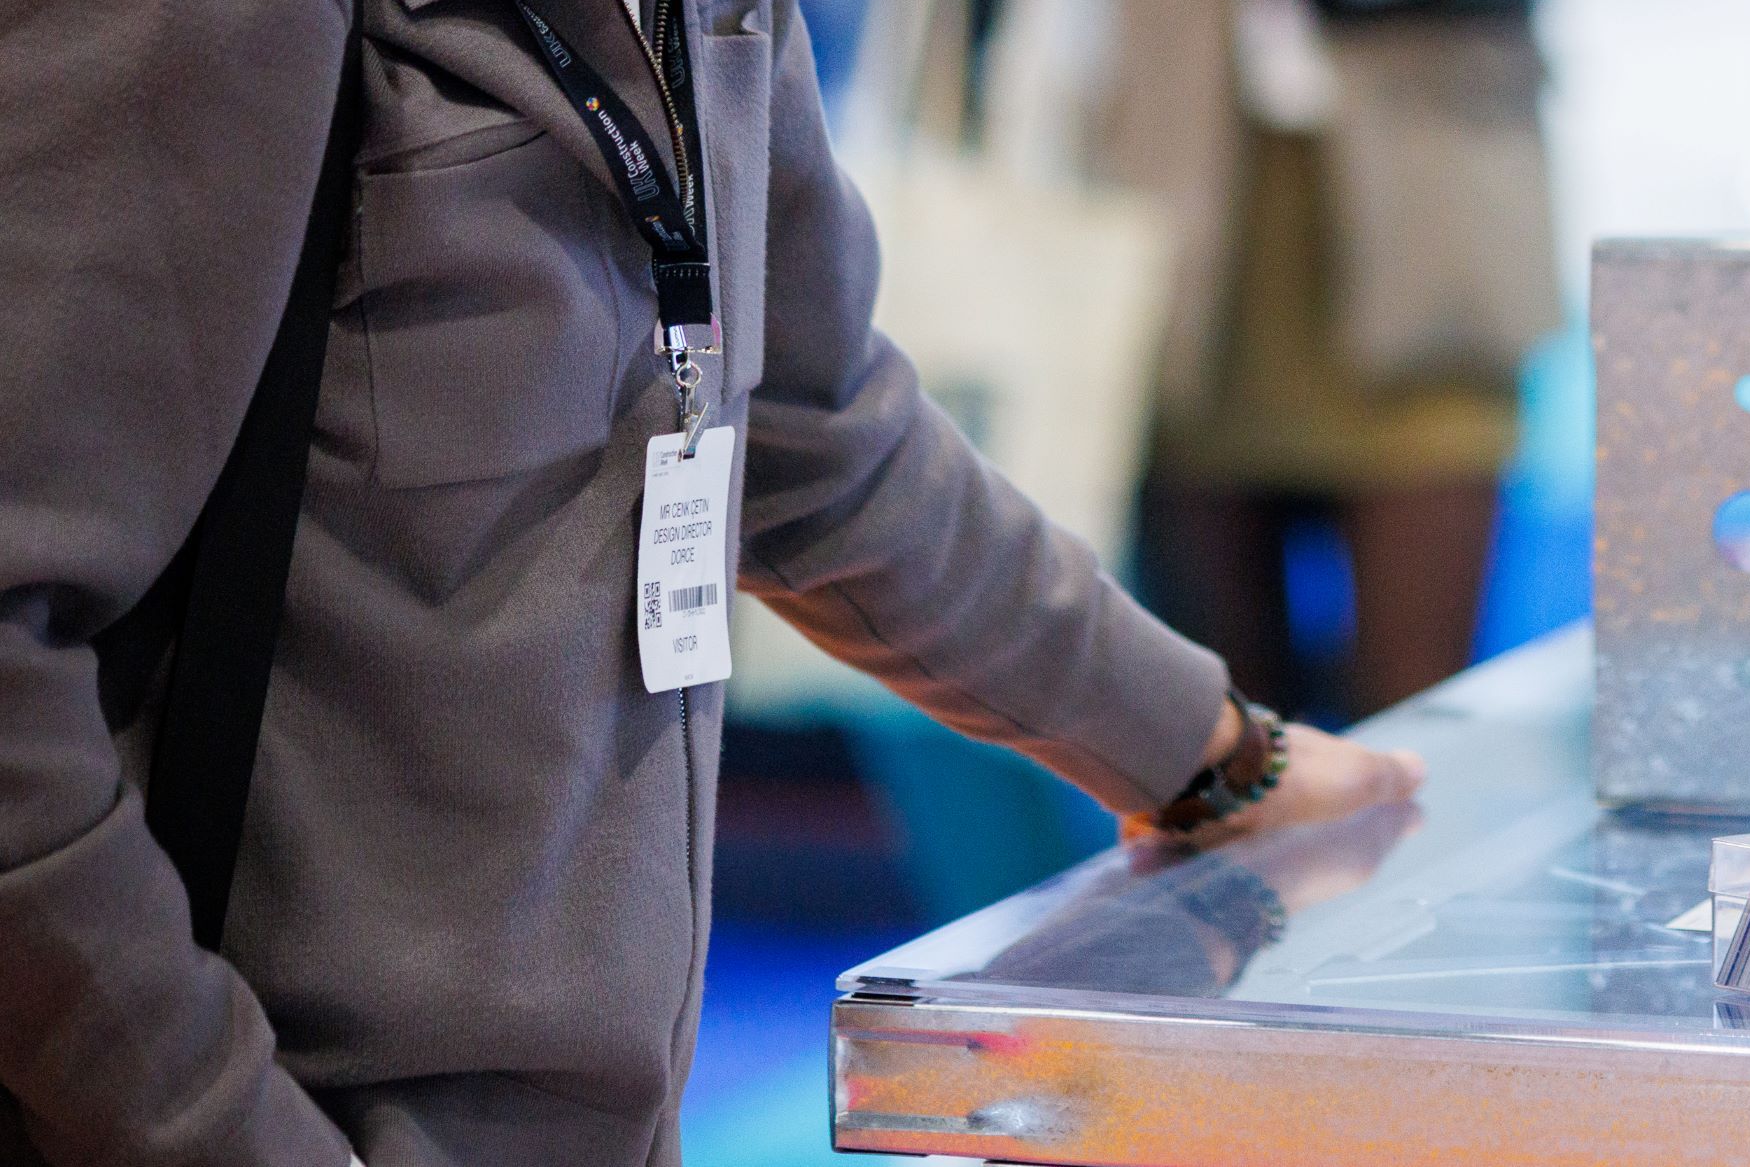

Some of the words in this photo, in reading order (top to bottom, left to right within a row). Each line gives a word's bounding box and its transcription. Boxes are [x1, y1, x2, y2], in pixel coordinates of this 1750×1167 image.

[598, 110, 639, 179] Construction
[629, 140, 650, 174] Week
[629, 170, 660, 202] UK
[660, 504, 671, 520] MR
[672, 501, 690, 518] CENK
[653, 527, 680, 544] DESIGN
[681, 521, 712, 540] DIRECTOR
[671, 547, 695, 565] DORCE
[672, 635, 698, 654] VISITOR
